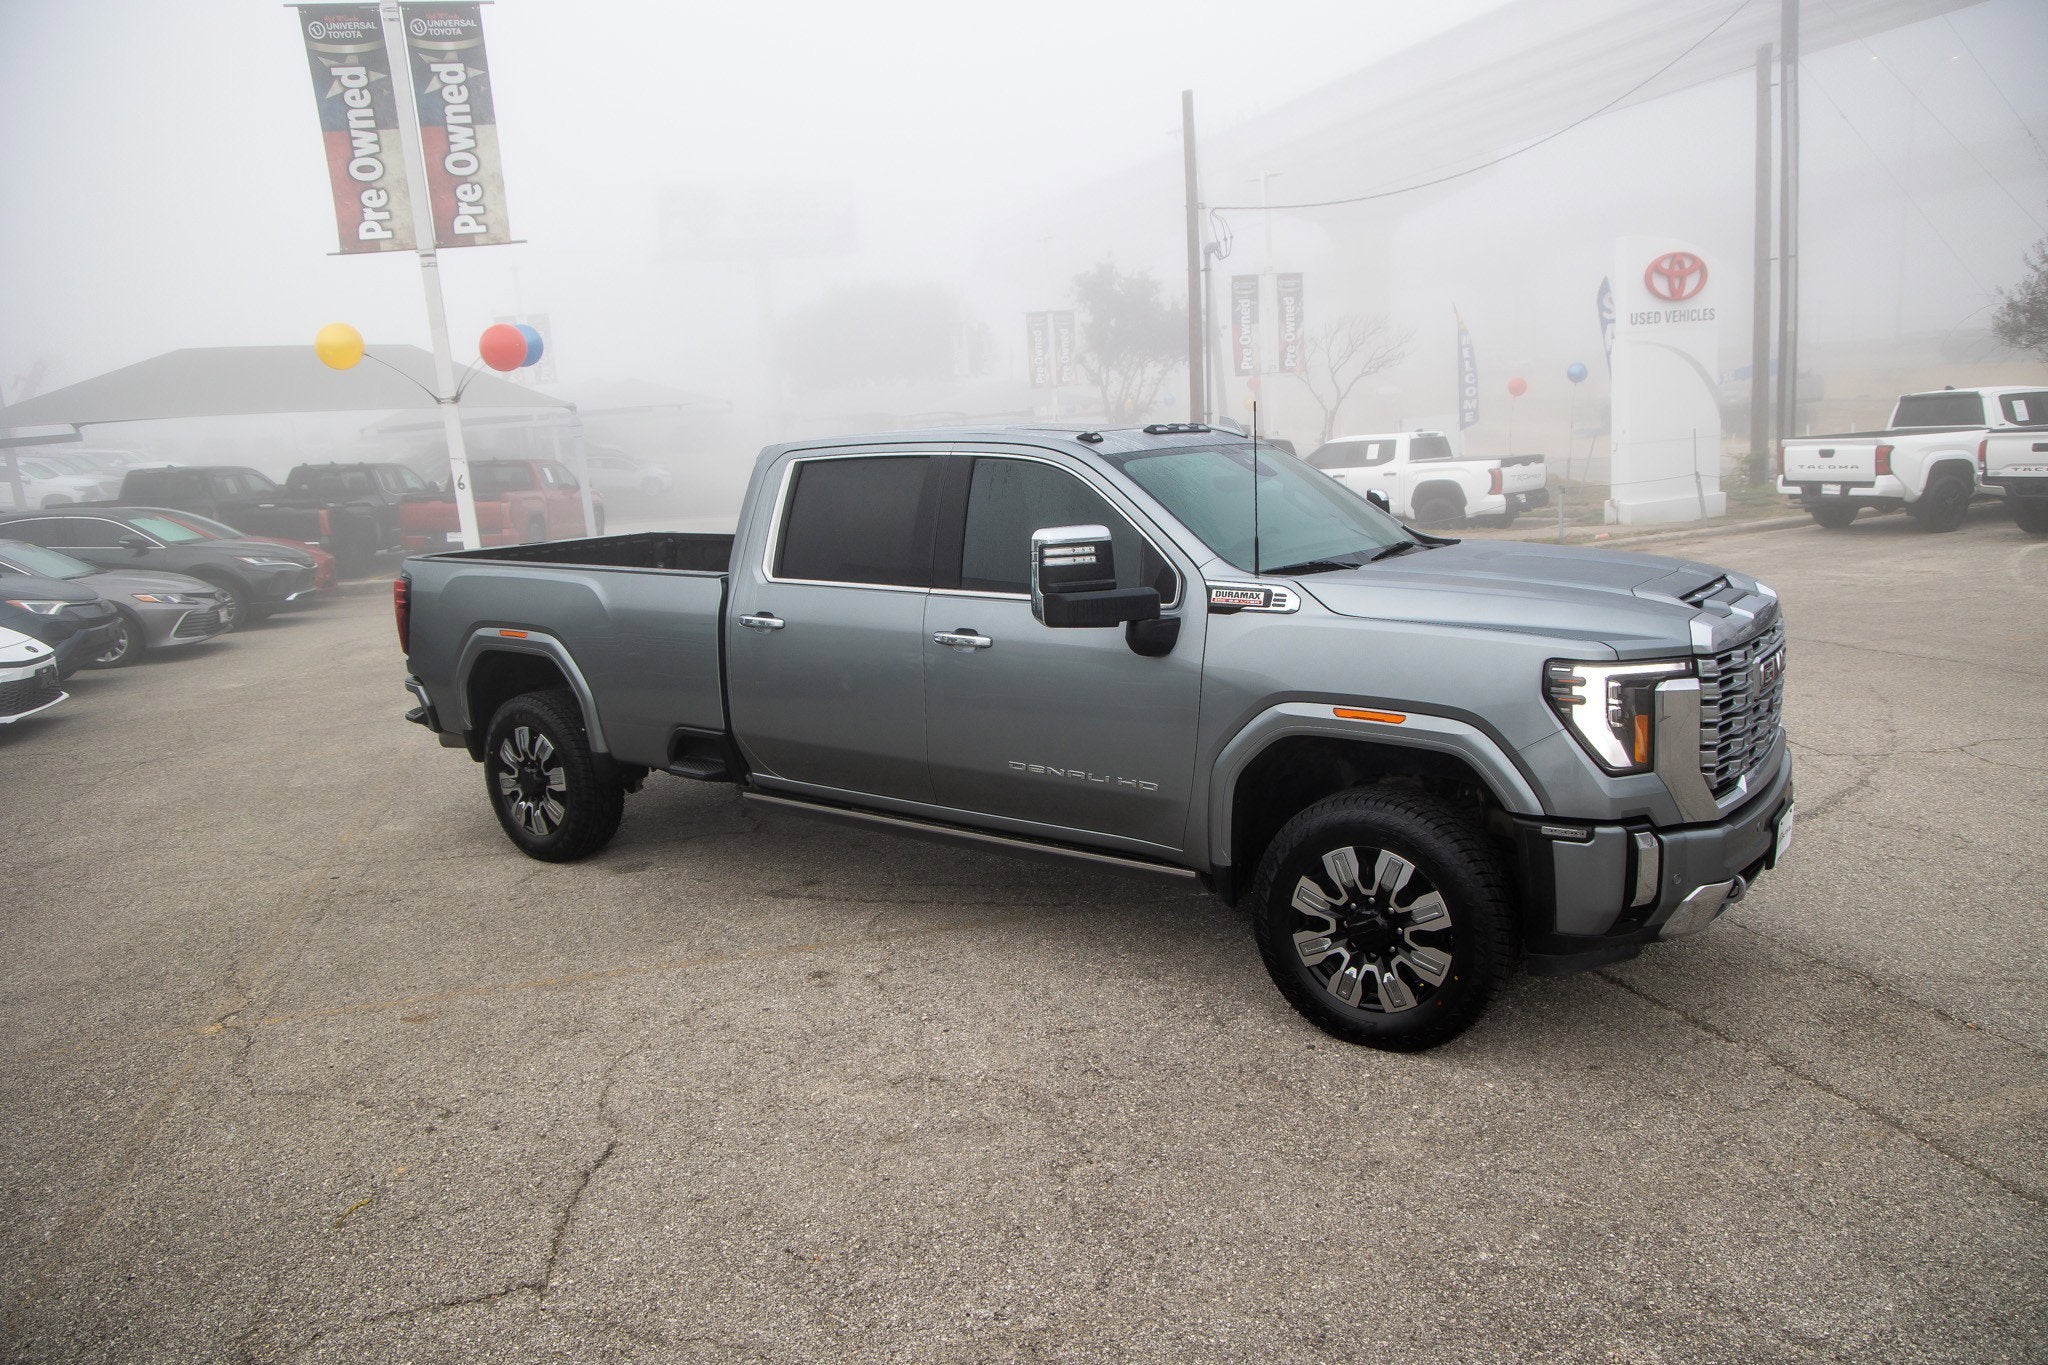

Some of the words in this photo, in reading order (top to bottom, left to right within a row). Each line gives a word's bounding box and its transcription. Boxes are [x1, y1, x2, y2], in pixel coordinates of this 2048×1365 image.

[326, 21, 377, 30] UNIVERSAL
[427, 18, 477, 27] UNIVERSAL
[428, 27, 462, 36] TOYOTA
[328, 30, 363, 39] TOYOTA
[330, 66, 385, 182] Owned
[430, 62, 480, 177] Owned
[357, 188, 393, 241] Pre
[453, 182, 488, 235] Pre
[1238, 298, 1251, 345] Owned
[1282, 296, 1296, 342] Owned
[1630, 311, 1661, 325] USED
[1664, 307, 1716, 323] VEHICLES
[1241, 348, 1254, 370] Pre
[1285, 344, 1298, 367] Pre
[457, 474, 465, 490] 6
[1215, 590, 1262, 600] DURAMAX
[1008, 760, 1110, 784] DENALI
[1117, 776, 1159, 792] HD
